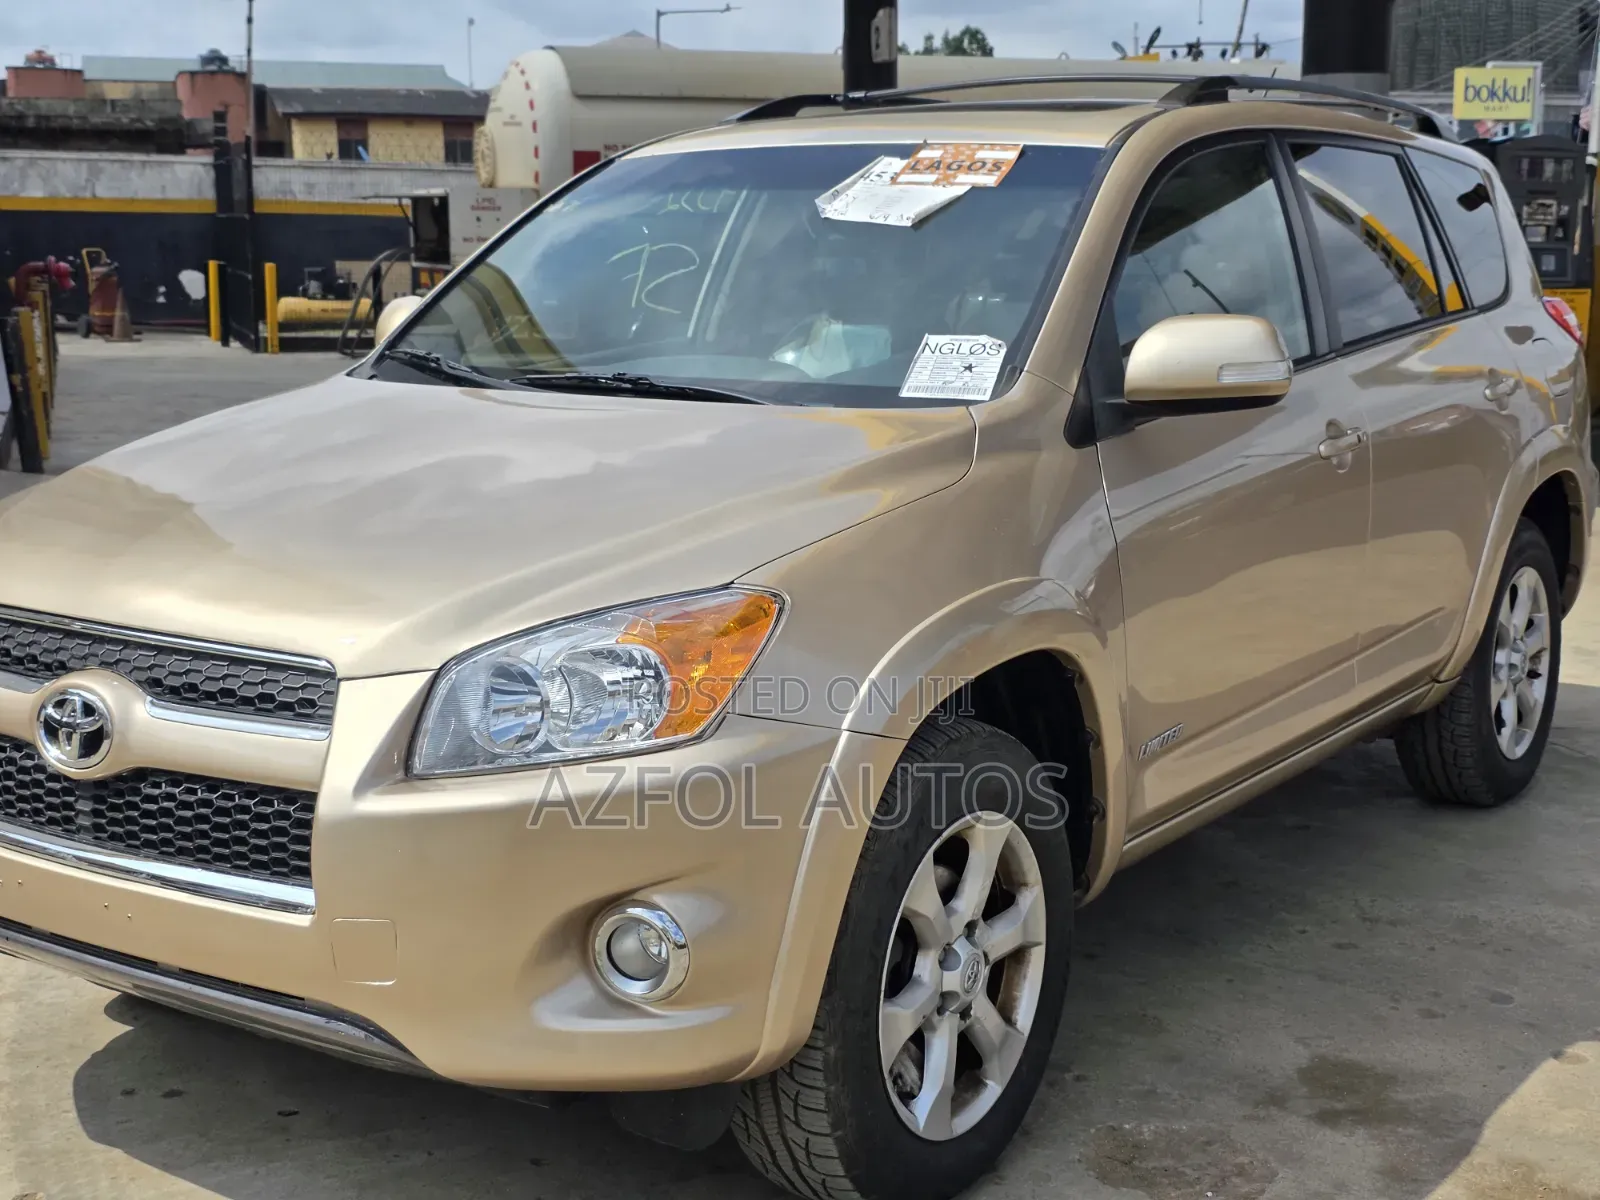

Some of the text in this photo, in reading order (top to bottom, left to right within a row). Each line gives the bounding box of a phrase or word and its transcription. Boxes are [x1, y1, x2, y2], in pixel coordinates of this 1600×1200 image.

[1463, 76, 1533, 104] bokku!
[909, 160, 1005, 172] LAGOS
[1137, 722, 1184, 761] LIMITED
